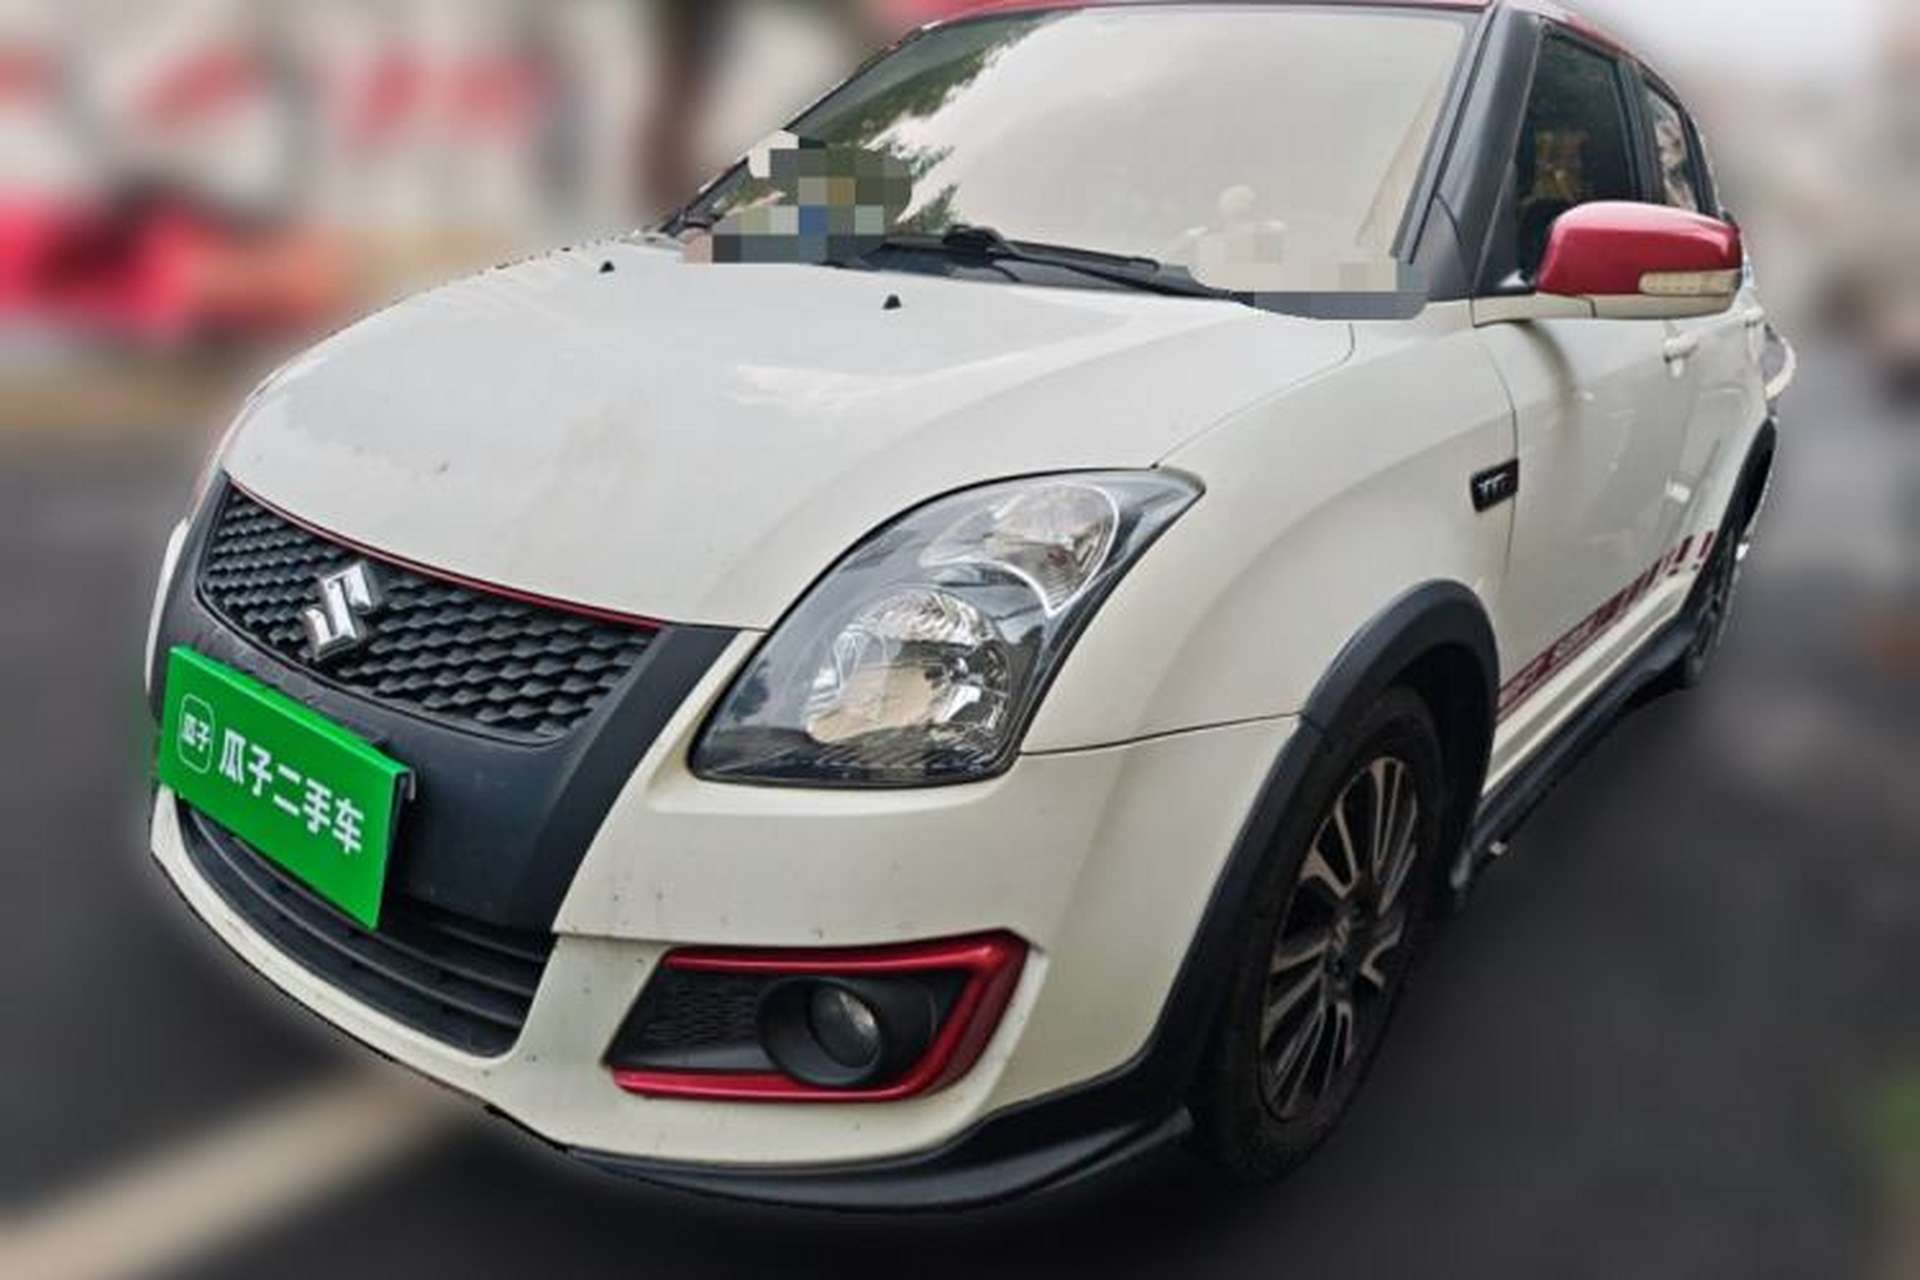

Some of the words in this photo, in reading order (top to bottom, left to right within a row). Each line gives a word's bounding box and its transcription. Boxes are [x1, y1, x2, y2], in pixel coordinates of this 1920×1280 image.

[219, 728, 364, 854] 瓜子二手车
